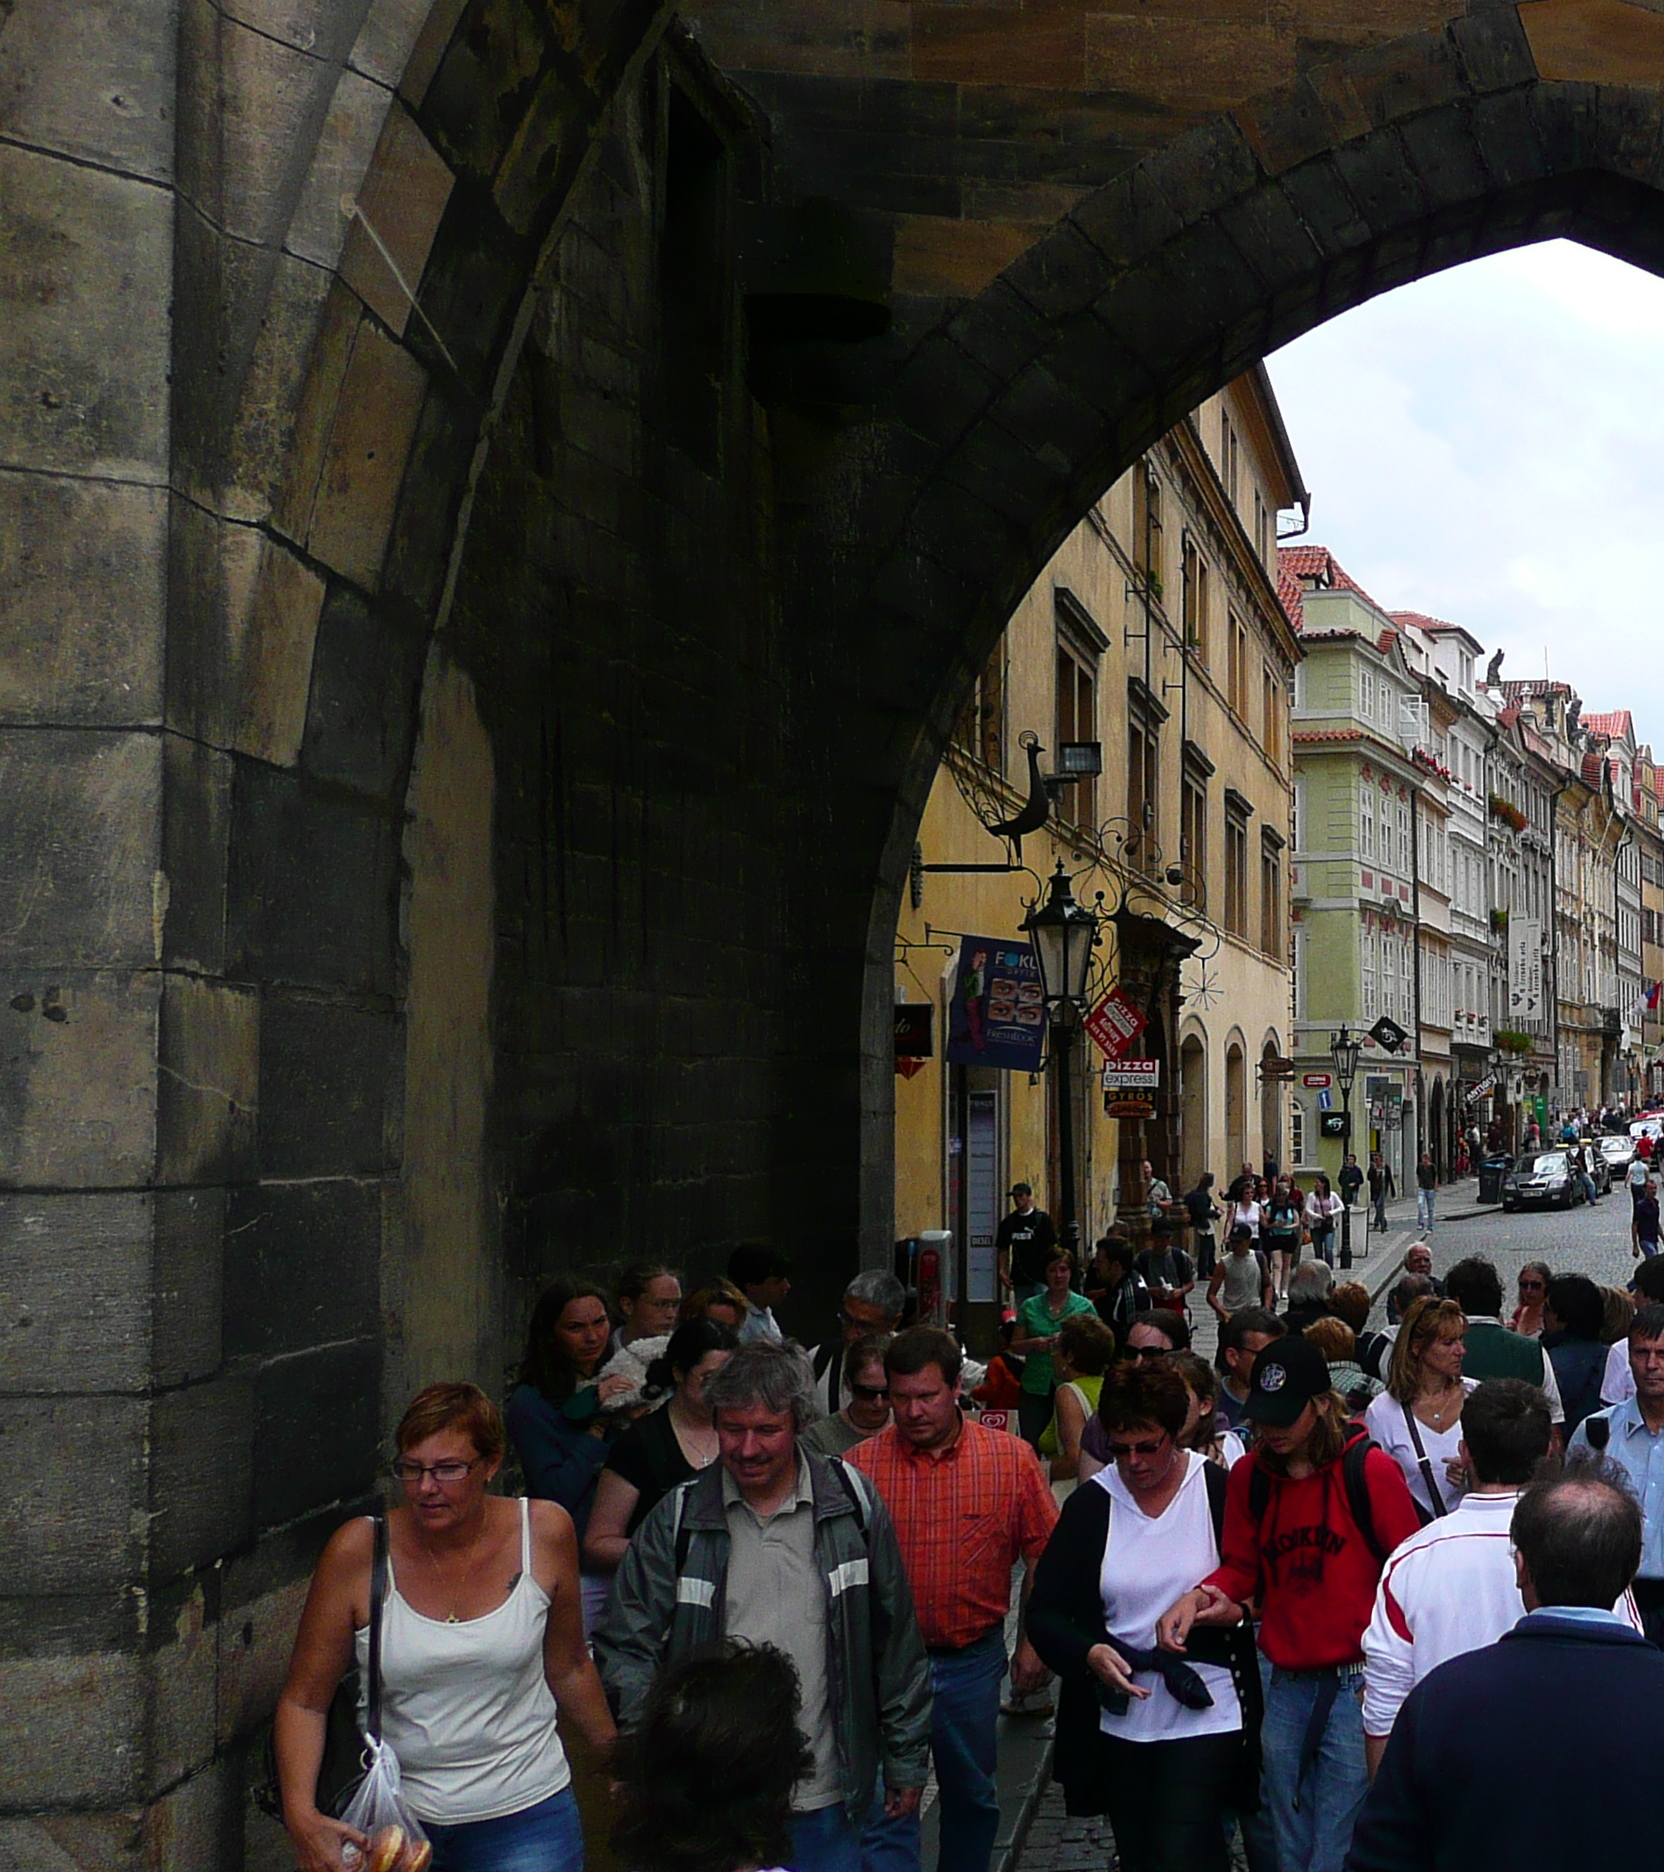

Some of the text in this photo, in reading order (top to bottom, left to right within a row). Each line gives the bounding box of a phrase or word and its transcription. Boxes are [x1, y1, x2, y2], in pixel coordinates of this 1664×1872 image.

[1105, 1059, 1154, 1072] pizza
[1105, 1074, 1154, 1086] express
[1108, 1092, 1154, 1101] GYROS
